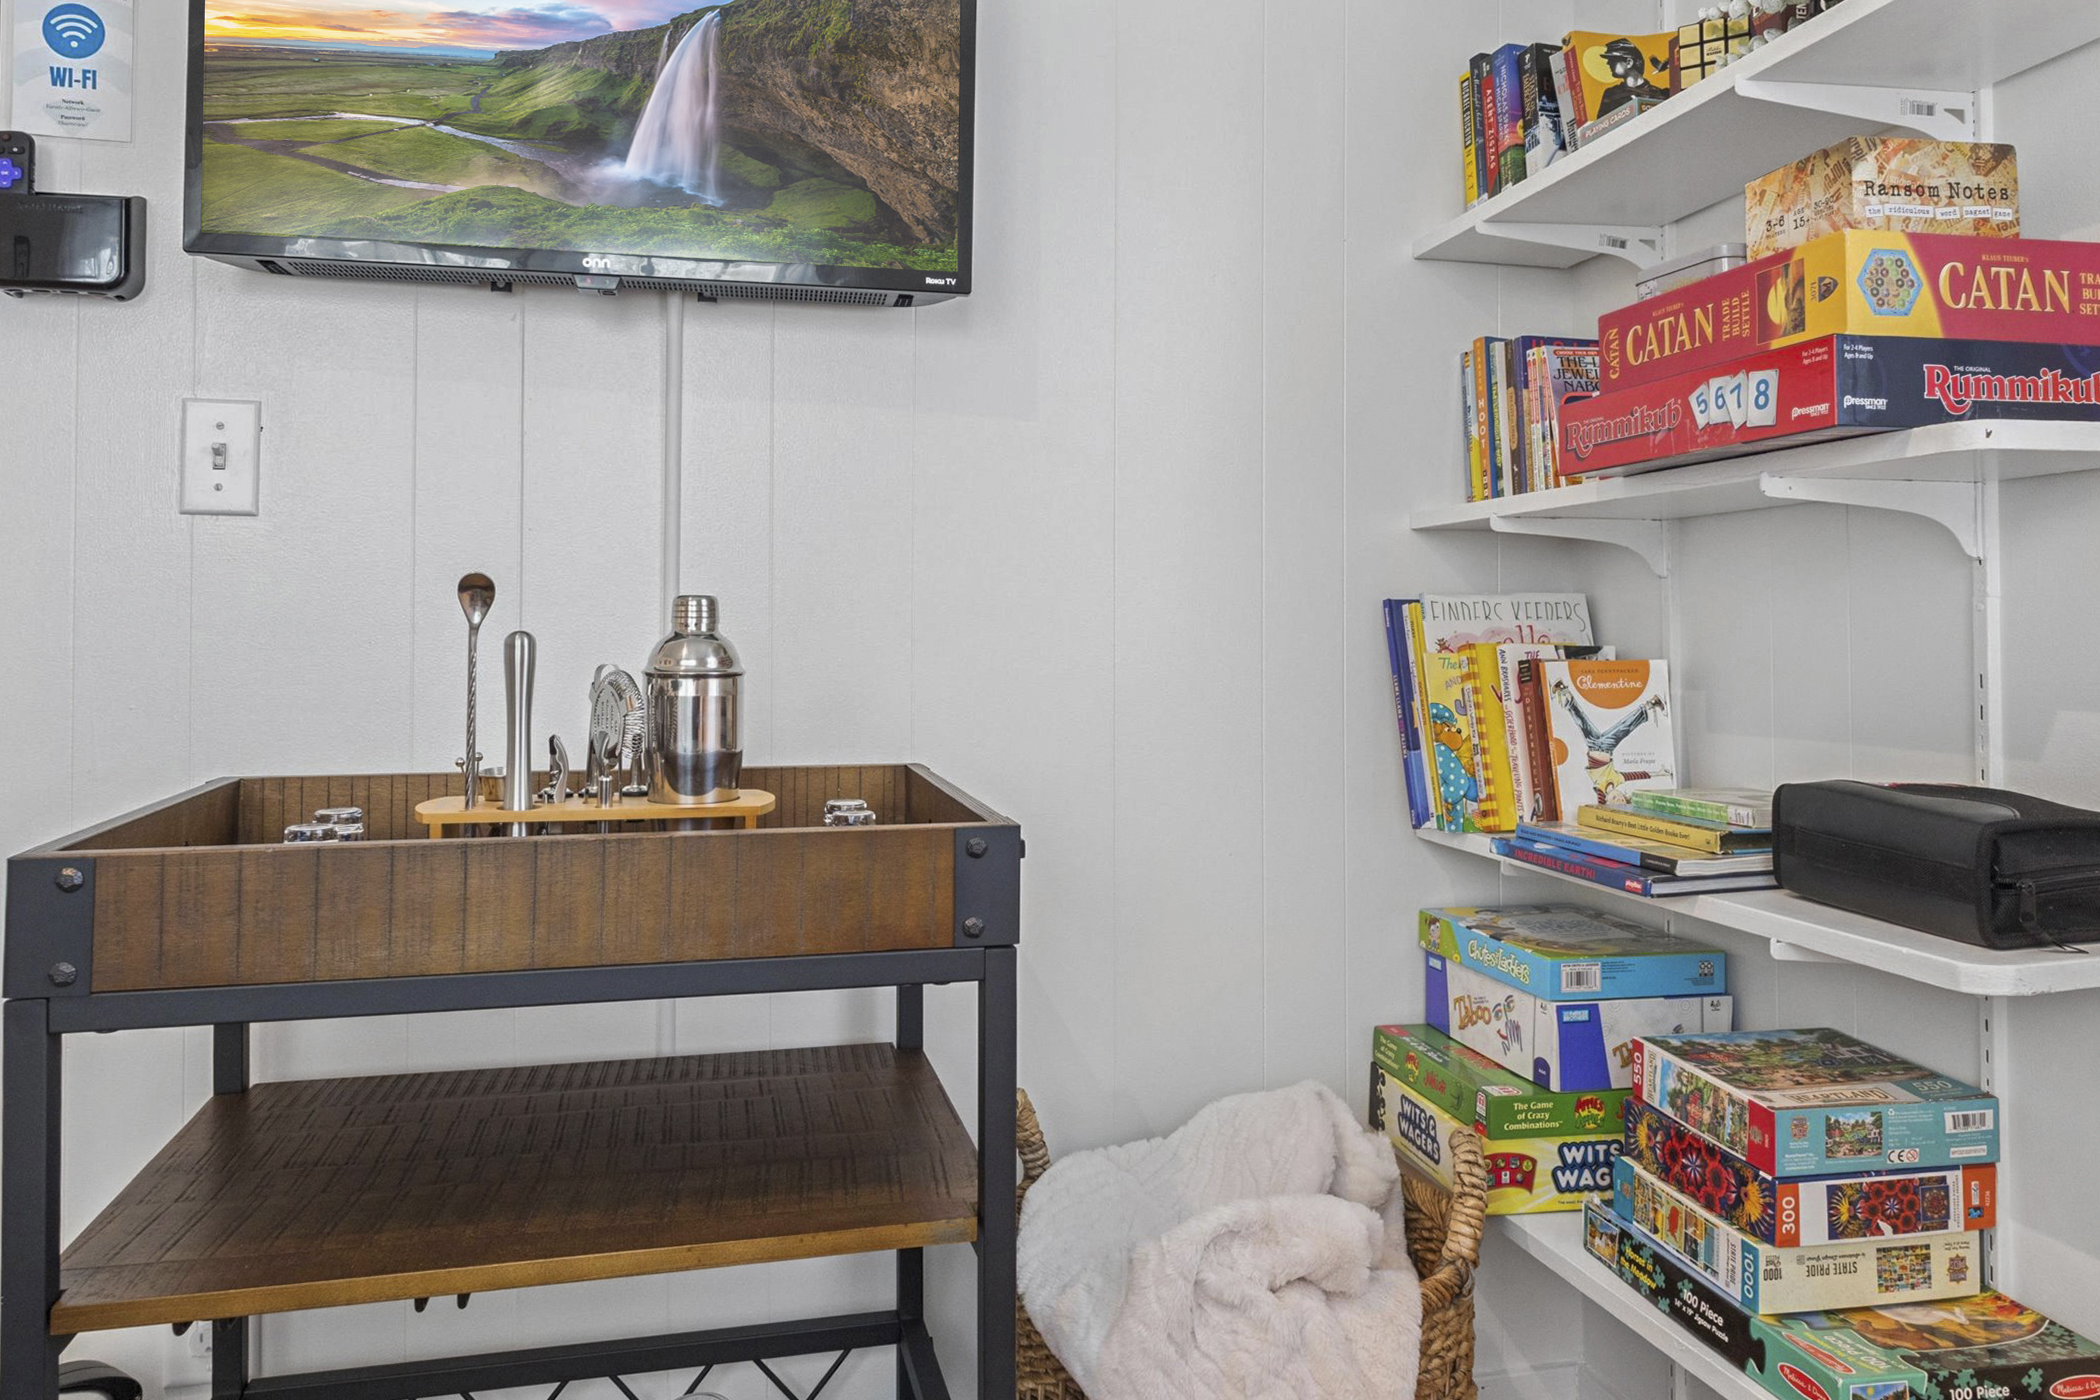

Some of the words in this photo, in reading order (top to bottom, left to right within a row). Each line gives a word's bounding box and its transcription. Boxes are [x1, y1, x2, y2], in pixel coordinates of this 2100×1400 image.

[49, 66, 97, 90] WI-FI
[1500, 65, 1509, 113] NICHOLAS
[1462, 80, 1471, 111] MICHAEL
[1485, 88, 1494, 122] AGENT
[1585, 119, 1609, 138] PLAYING
[1609, 107, 1631, 124] CARDS
[1488, 127, 1496, 169] ZIGZAG
[1465, 148, 1474, 190] NEXT
[1863, 180, 1941, 198] Ransom
[1947, 182, 2009, 200] Notes
[1765, 215, 1785, 232] 3-6
[1793, 216, 1810, 230] 15+
[1868, 207, 1881, 215] the
[1889, 206, 1930, 216] ridiculous
[1940, 209, 1958, 217] word
[1964, 208, 1991, 217] magnet
[1982, 254, 2001, 262] KLAUS
[925, 277, 945, 285] Roku
[946, 278, 957, 286] TV
[1939, 262, 2070, 314] CATAN
[1722, 298, 1731, 341] TRADE
[1732, 297, 1741, 336] BUILD
[1741, 290, 1751, 338] SETTLE
[1626, 303, 1714, 366] CATAN
[1557, 356, 1588, 368] THE
[1609, 327, 1619, 379] CATAN
[1695, 391, 1708, 415] 5
[1714, 384, 1726, 405] 6
[1729, 382, 1742, 409] 7
[1753, 377, 1770, 410] 8
[1843, 395, 1888, 408] pressman
[1478, 399, 1487, 449] HOOT
[1567, 398, 1683, 458] Rummikub
[1438, 657, 1457, 670] The
[1498, 649, 1507, 665] ANN
[1444, 677, 1462, 691] AND
[1500, 666, 1512, 701] BRASHARES
[1576, 675, 1643, 691] Clementine
[1511, 754, 1522, 790] TRAVELING
[1514, 790, 1524, 814] PANTS
[1596, 814, 1612, 825] Richard
[1627, 821, 1637, 829] Best
[1637, 822, 1649, 832] Little
[1649, 825, 1664, 835] Golden
[1664, 828, 1679, 838] Books
[1679, 831, 1690, 840] Ever!
[1514, 848, 1561, 870] INCREDIBLE
[1563, 863, 1596, 880] EARTH!
[1468, 939, 1497, 967] Chutes
[1498, 948, 1531, 984] Ladders
[1453, 995, 1492, 1030] Taboo
[1386, 1039, 1398, 1051] Game
[1633, 1052, 1643, 1085] 550
[1791, 1088, 1890, 1102] HEARTLAND
[1912, 1080, 1953, 1091] 550
[1402, 1097, 1427, 1129] WITS
[1517, 1112, 1526, 1120] of
[1527, 1112, 1550, 1120] Crazy
[1530, 1102, 1554, 1110] Game
[1399, 1114, 1439, 1161] WAGERS
[1782, 1196, 1795, 1235] 300
[1620, 1257, 1630, 1270] the
[1630, 1264, 1657, 1290] Meadow
[1625, 1246, 1646, 1268] Horses
[1646, 1263, 1653, 1272] in
[1729, 1263, 1737, 1285] PRIDE
[1806, 1263, 1830, 1278] PRIDE
[1832, 1261, 1858, 1275] STATE
[1743, 1252, 1754, 1298] 1000
[1763, 1267, 1783, 1282] 1000
[1682, 1289, 1699, 1308] 100
[1700, 1301, 1724, 1327] Piece
[1694, 1313, 1712, 1331] Jigsaw
[1711, 1325, 1729, 1343] Puzzle
[1782, 1365, 1809, 1388] Melissa
[2053, 1381, 2081, 1396] Melissa
[1949, 1387, 1974, 1400] 100
[1975, 1385, 2010, 1400] Piece
